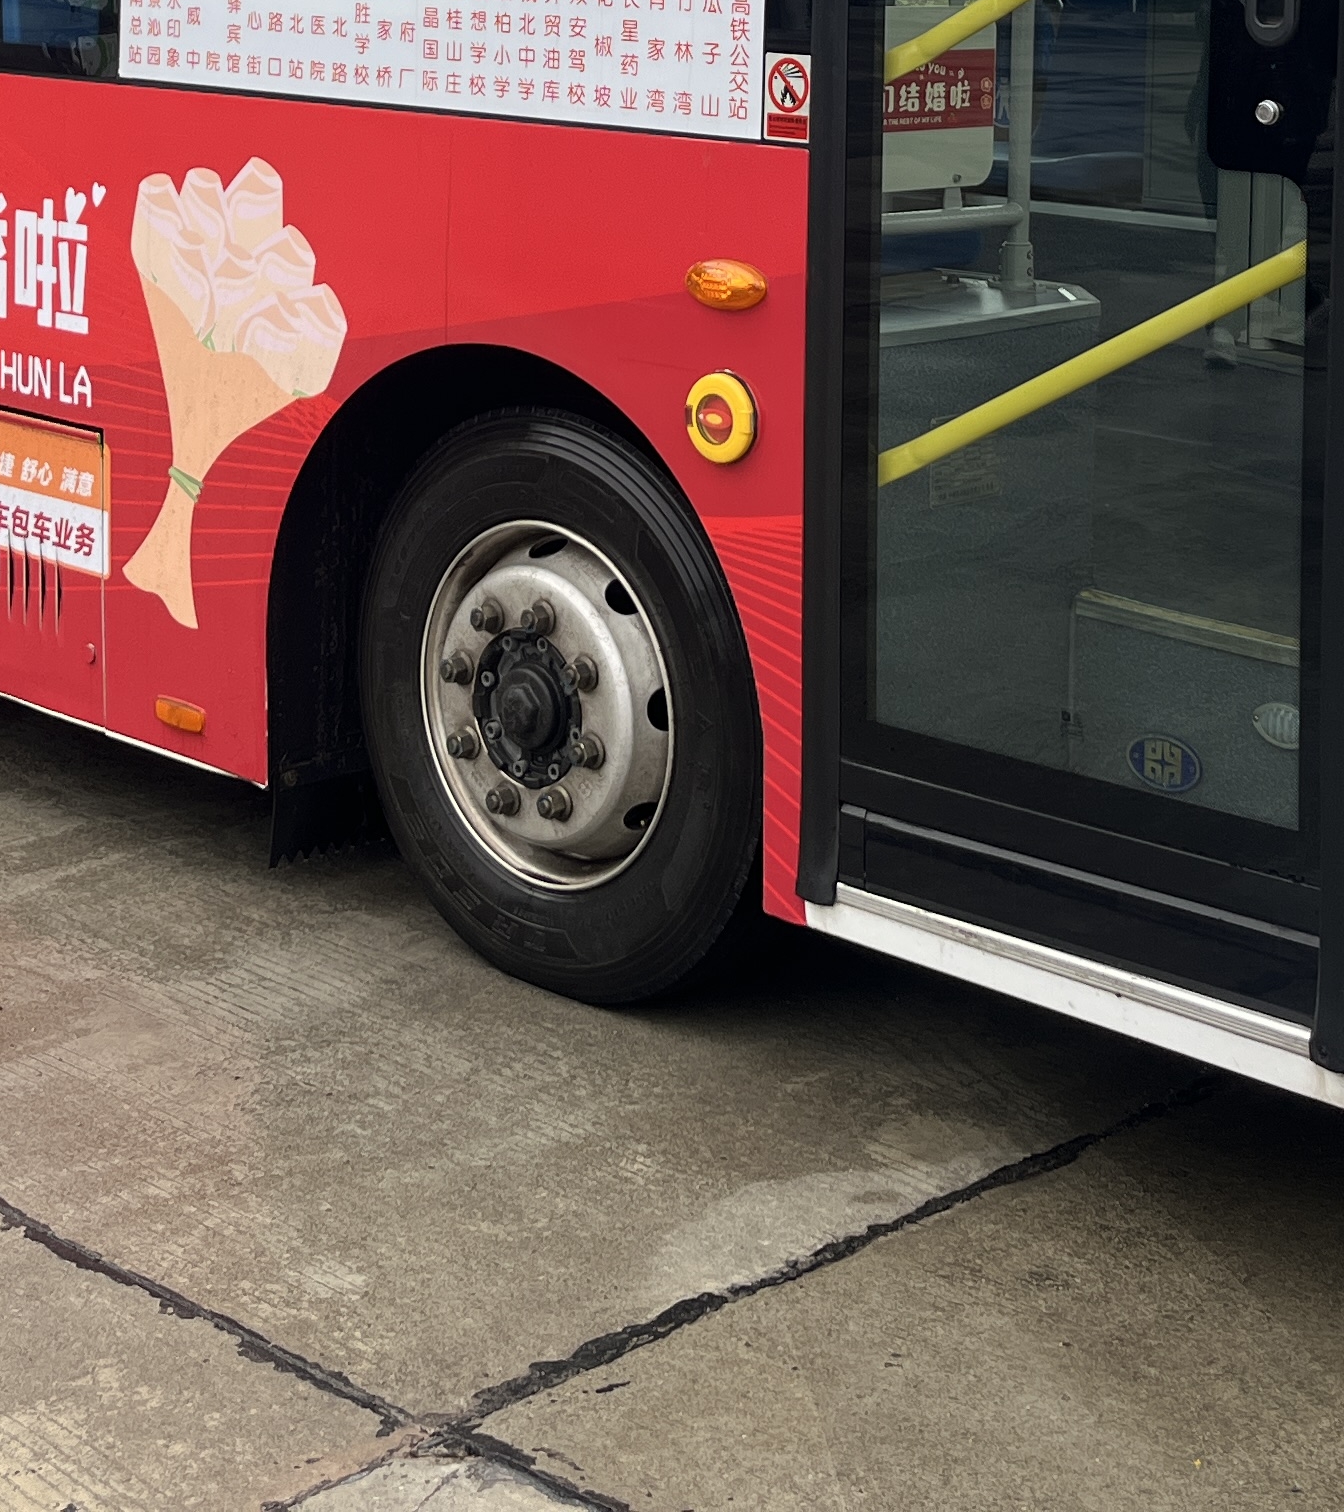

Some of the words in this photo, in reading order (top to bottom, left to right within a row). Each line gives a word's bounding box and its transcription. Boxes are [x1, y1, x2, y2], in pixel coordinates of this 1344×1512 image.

[0, 349, 52, 400] HUN
[59, 363, 93, 409] LA
[21, 456, 53, 488] 舒心
[60, 465, 96, 499] 满意
